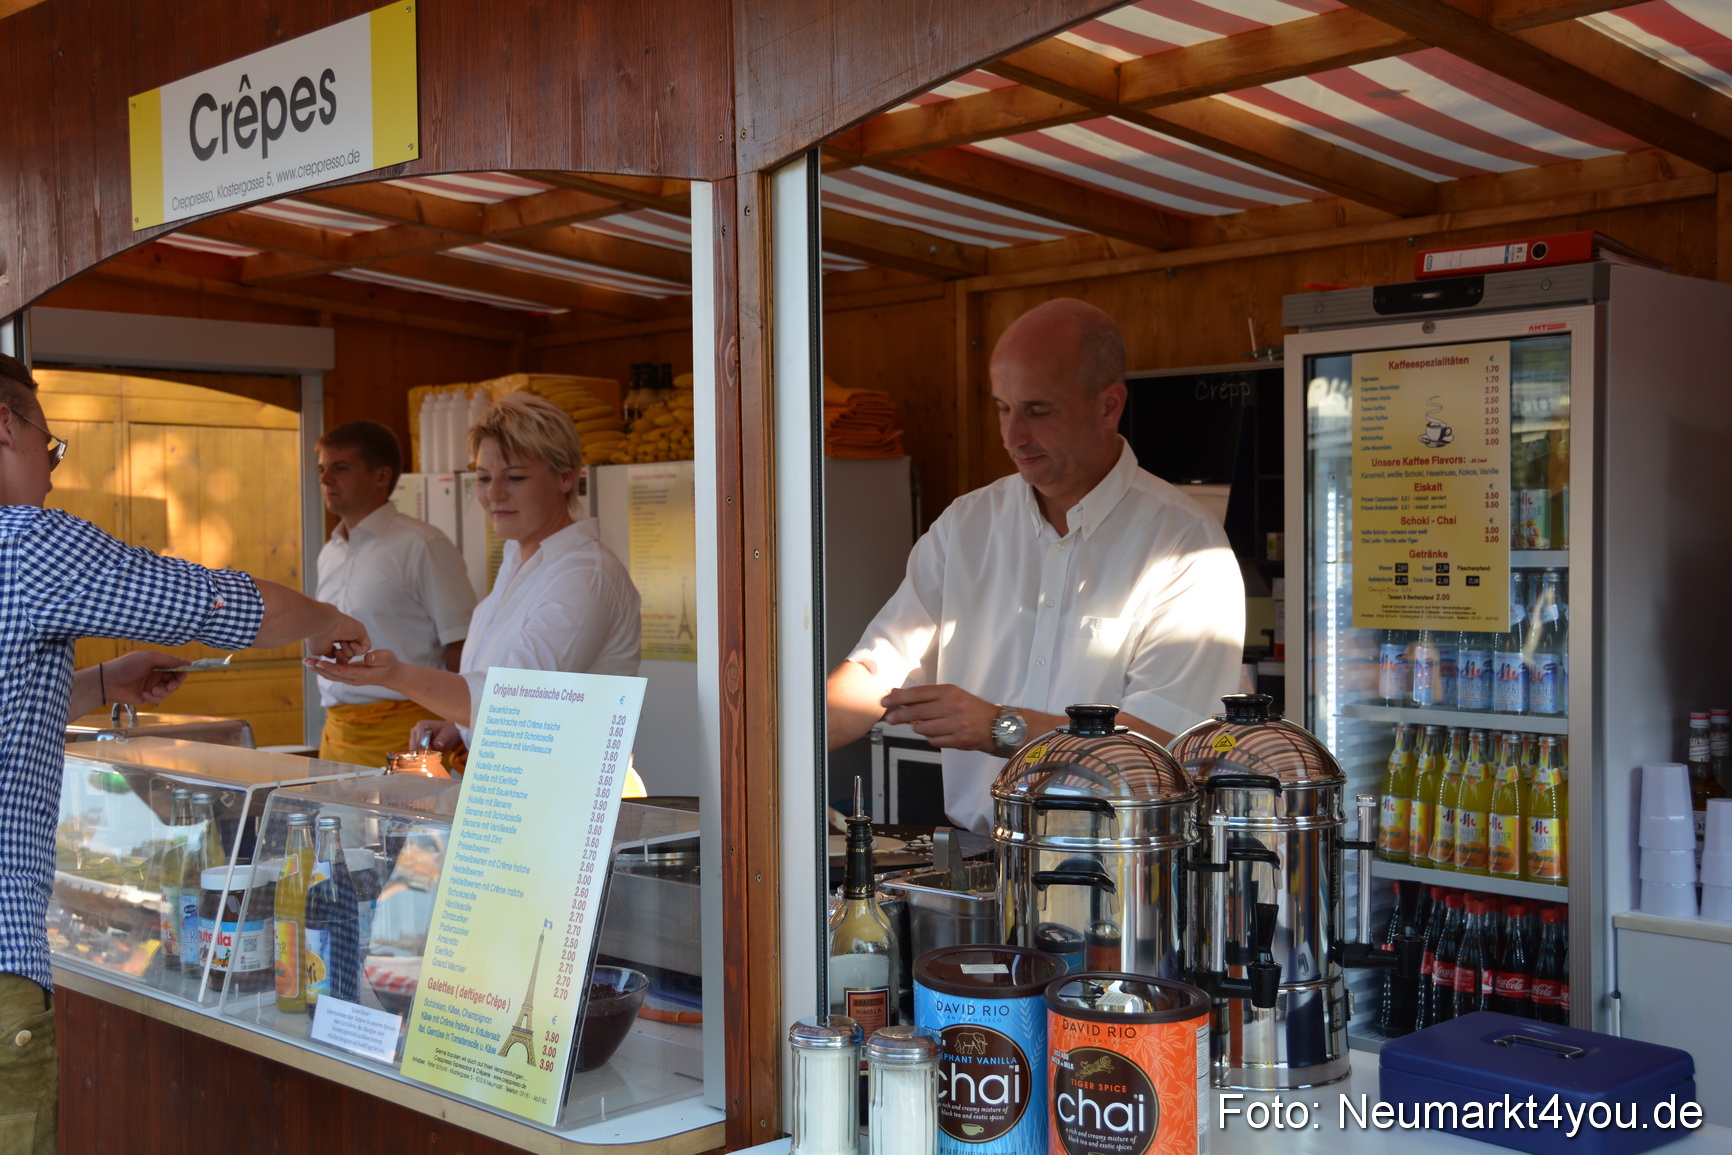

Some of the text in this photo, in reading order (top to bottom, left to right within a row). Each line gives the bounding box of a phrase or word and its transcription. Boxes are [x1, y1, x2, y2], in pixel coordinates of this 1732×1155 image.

[189, 68, 337, 160] Crêpes
[172, 149, 361, 212] Creppresso, Klostergasse 5, www.creppresso.de
[1389, 357, 1469, 370] Kaffeespezialitäten
[1485, 365, 1499, 373] 1.70
[1485, 386, 1499, 394] 2.70
[1485, 396, 1499, 404] 2.50
[1485, 417, 1499, 425] 2.70
[1485, 438, 1499, 446] 3.00
[1372, 456, 1466, 467] Unsere Kaffee Flavors:
[1414, 483, 1442, 491] Eiskalt
[1401, 516, 1429, 525] Schoki
[1437, 516, 1456, 525] Chai
[1485, 526, 1499, 534] 3.00
[1409, 550, 1448, 558] Getränke
[493, 684, 584, 703] Original französische Crêpes
[489, 705, 626, 725] Sauerkirsche 3.20
[484, 727, 515, 738] Sauerkirsche
[515, 731, 524, 739] mit
[606, 739, 621, 750] 3.60
[609, 727, 624, 737] 3.60
[481, 738, 512, 749] Sauerkirsche
[522, 743, 552, 754] Vanillesauce
[604, 751, 618, 762] 3.60
[478, 750, 615, 774] Nutella 3.20
[475, 761, 613, 786] Nutella mit Amaretto 3.60
[473, 772, 610, 798] Nutella mit Eierlikör 3.60
[470, 784, 487, 794] Nutella
[496, 787, 528, 799] Sauerkirsche
[593, 800, 607, 811] 3.90
[468, 795, 605, 823] Nutella mit Banane 3.90
[465, 806, 484, 817] Banane
[484, 810, 492, 818] mit
[588, 824, 602, 836] 3.60
[462, 818, 481, 828] Banane
[481, 822, 490, 830] mit
[585, 837, 599, 848] 3.60
[460, 830, 597, 861] Apfelmus mit Zimt 2.70
[458, 841, 594, 873] Preiselbeeren 2.60
[452, 864, 589, 898] Heidelbeeren 2.60
[577, 874, 592, 886] 3.00
[572, 899, 586, 911] 3.00
[569, 911, 584, 923] 2.70
[442, 910, 578, 949] Zimtzucker 2.50
[566, 924, 581, 936] 2.70
[440, 922, 576, 962] Puderzucker 2.00
[437, 934, 573, 974] Amaretto 2.70
[434, 945, 570, 987] Eierlikör 2.70
[432, 957, 568, 1000] Grand Marnier 2.70
[428, 977, 454, 995] Galettes
[459, 986, 485, 1004] deftiger
[484, 992, 508, 1012] Crêpe
[936, 1000, 1010, 1016] DAVID RIO
[424, 998, 559, 1044] Schinken, Käse, Champignon 3.90
[1062, 1018, 1137, 1038] DAVID RIO
[542, 1045, 556, 1058] 3.00
[976, 1056, 1017, 1065] VANILLA
[540, 1059, 554, 1072] 3.90
[938, 1062, 1020, 1105] chai
[1071, 1078, 1127, 1093] TIGER SPICE
[941, 1108, 952, 1116] black
[989, 1114, 1005, 1122] spices
[962, 1105, 980, 1114] creamy
[981, 1105, 1001, 1113] mixture
[1002, 1106, 1009, 1114] of
[1057, 1088, 1144, 1132] chai
[1068, 1134, 1079, 1144] black
[1088, 1140, 1098, 1148] and
[1099, 1141, 1115, 1149] exotic
[1116, 1143, 1132, 1152] spices
[1069, 1128, 1077, 1136] rich
[1078, 1130, 1087, 1138] and
[1088, 1133, 1106, 1142] creamy
[1129, 1135, 1138, 1144] of
